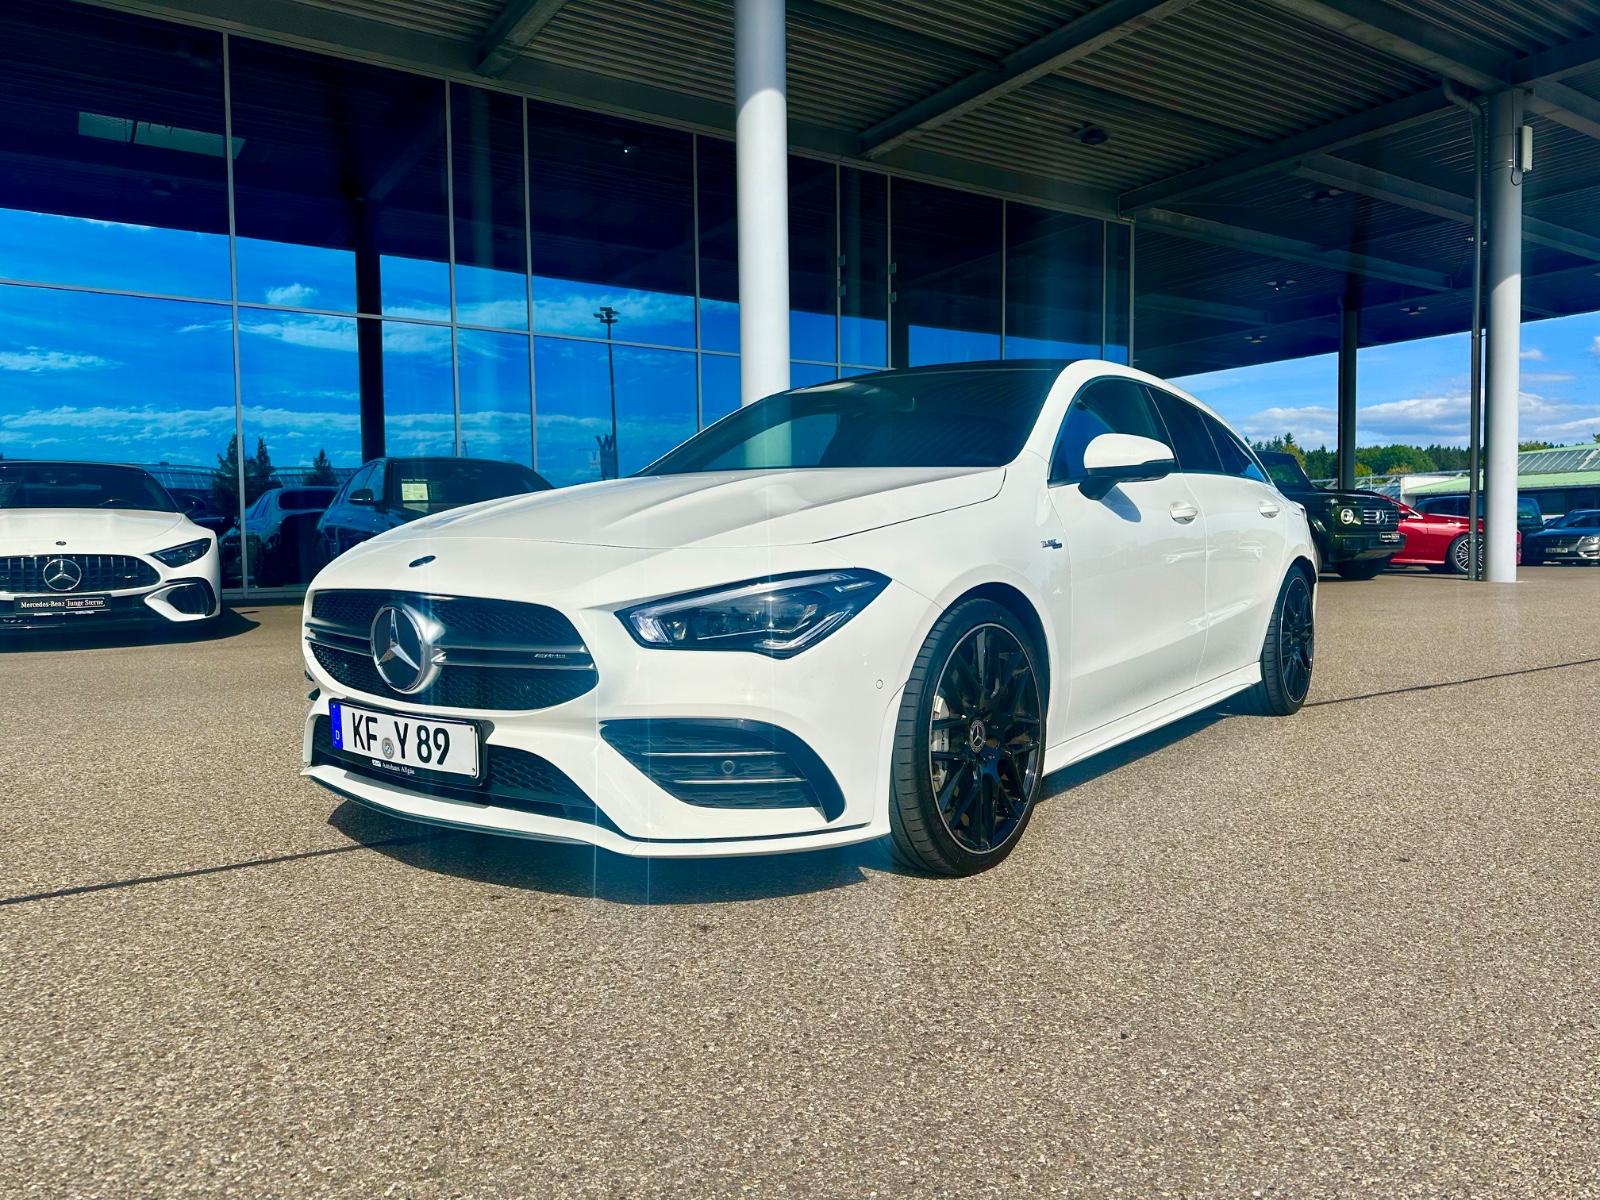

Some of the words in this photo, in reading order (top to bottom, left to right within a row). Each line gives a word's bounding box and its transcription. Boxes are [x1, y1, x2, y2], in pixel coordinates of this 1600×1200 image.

[352, 712, 378, 751] KF
[394, 721, 409, 759] Y
[416, 725, 450, 765] 89
